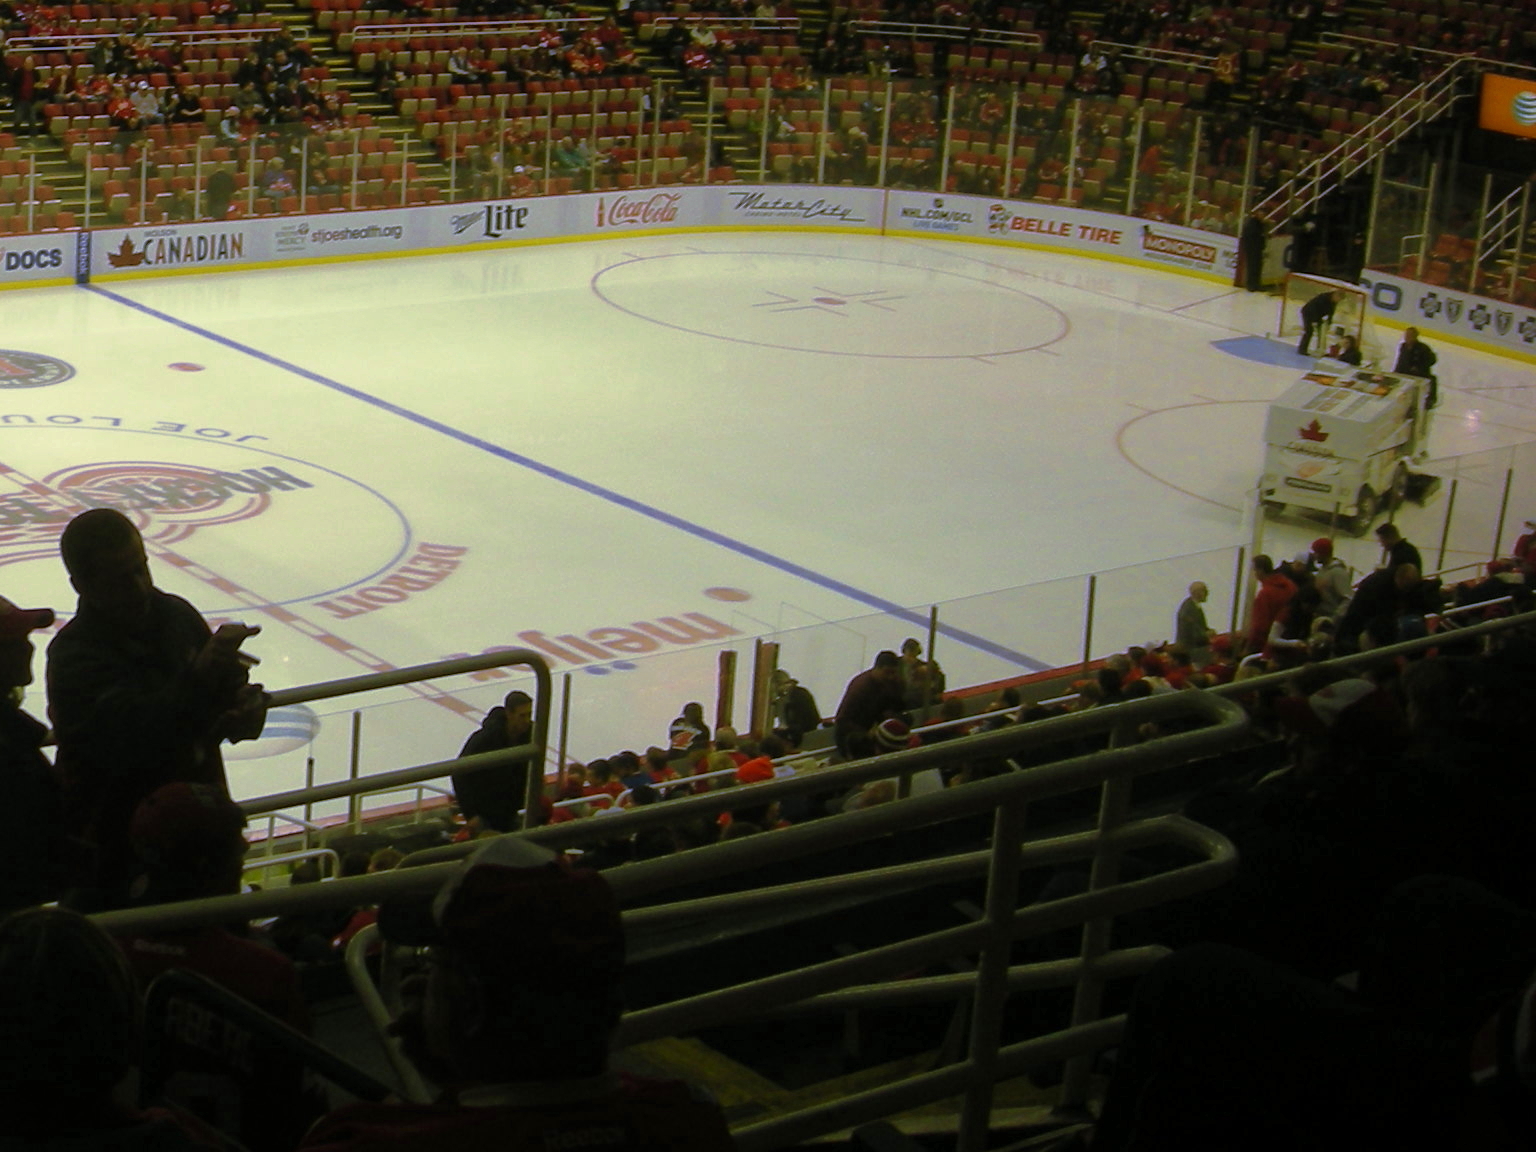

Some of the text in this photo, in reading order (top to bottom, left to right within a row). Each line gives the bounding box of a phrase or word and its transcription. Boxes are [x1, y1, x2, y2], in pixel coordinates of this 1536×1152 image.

[483, 202, 528, 239] Lite
[608, 193, 682, 226] Coca-Cola
[1010, 215, 1124, 246] BELLE TIRE
[4, 248, 63, 272] DOCS
[143, 232, 244, 266] CANADIAN
[1146, 234, 1215, 261] MONOPOLY
[151, 420, 271, 445] JOE
[314, 542, 469, 620] DETROIT
